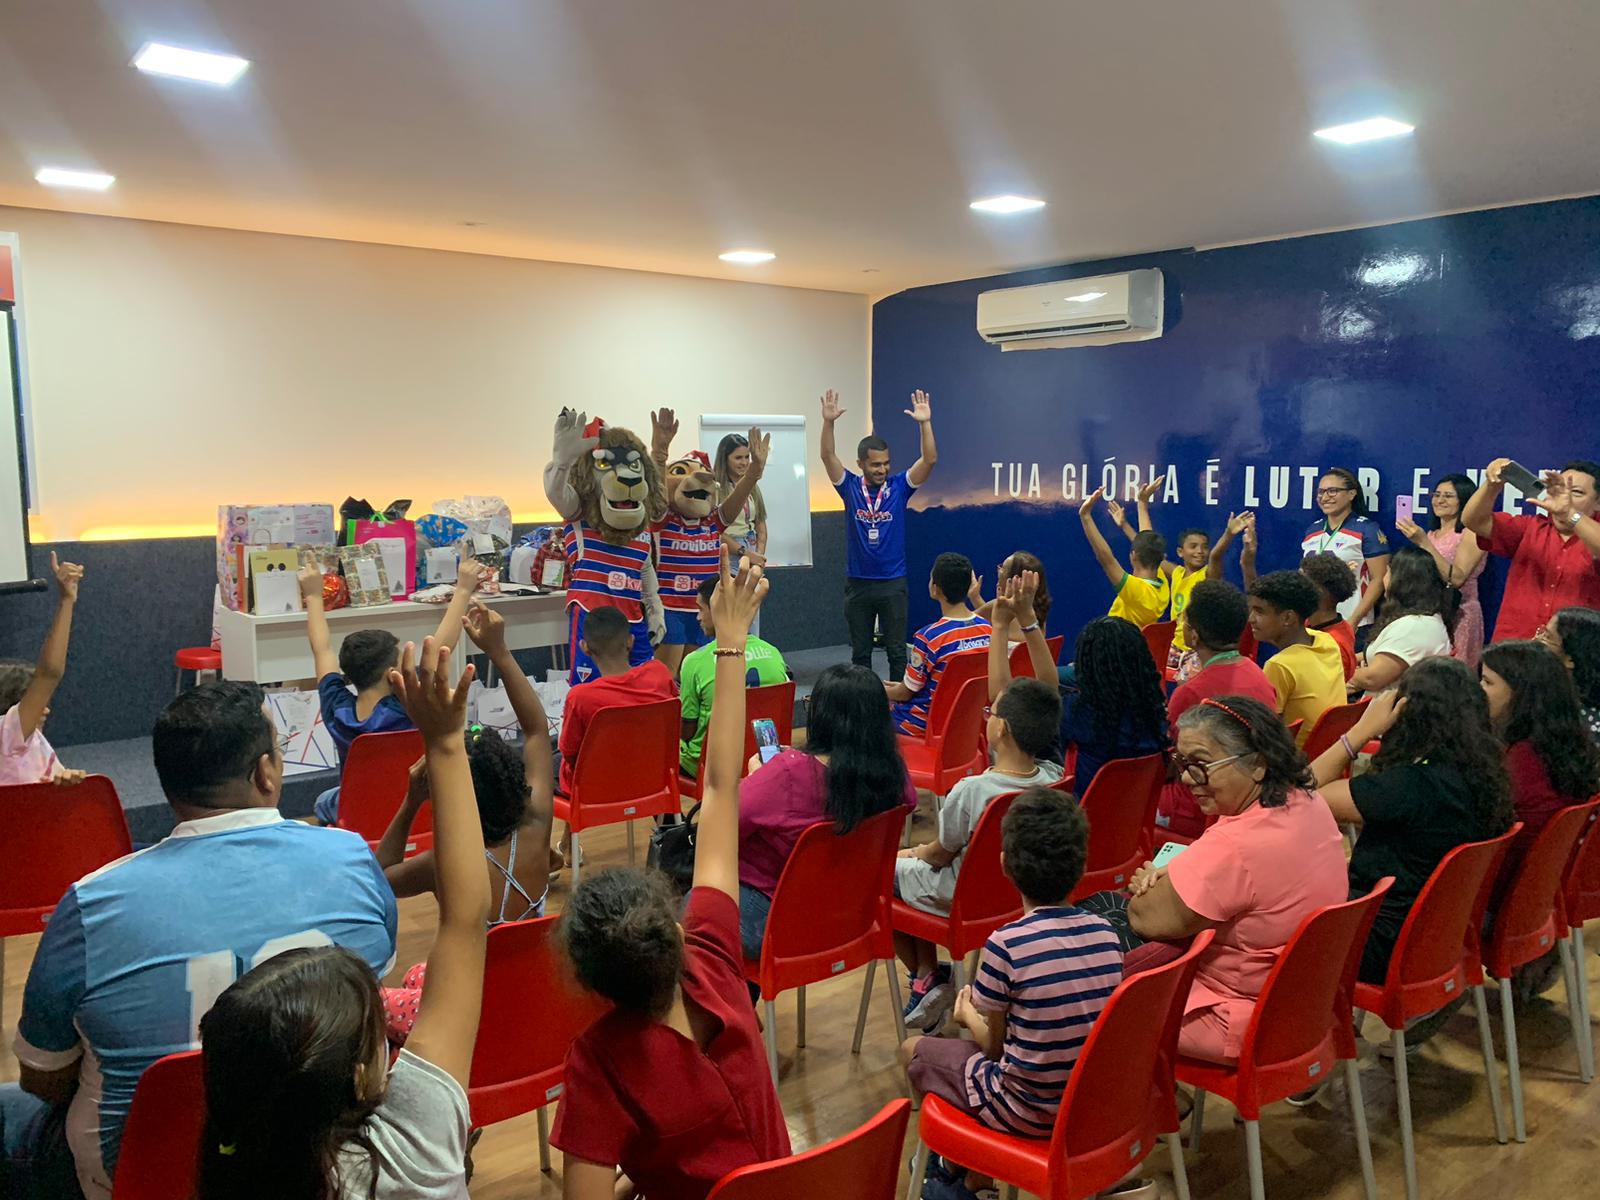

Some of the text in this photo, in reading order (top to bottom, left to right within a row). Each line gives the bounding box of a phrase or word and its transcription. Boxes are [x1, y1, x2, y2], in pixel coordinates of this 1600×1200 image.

[991, 462, 1041, 498] TUA
[1062, 456, 1180, 504] GLÓRIA
[1205, 458, 1221, 505] É
[1244, 465, 1381, 512] LUTR
[1412, 467, 1431, 515] E
[671, 539, 718, 552] novibet
